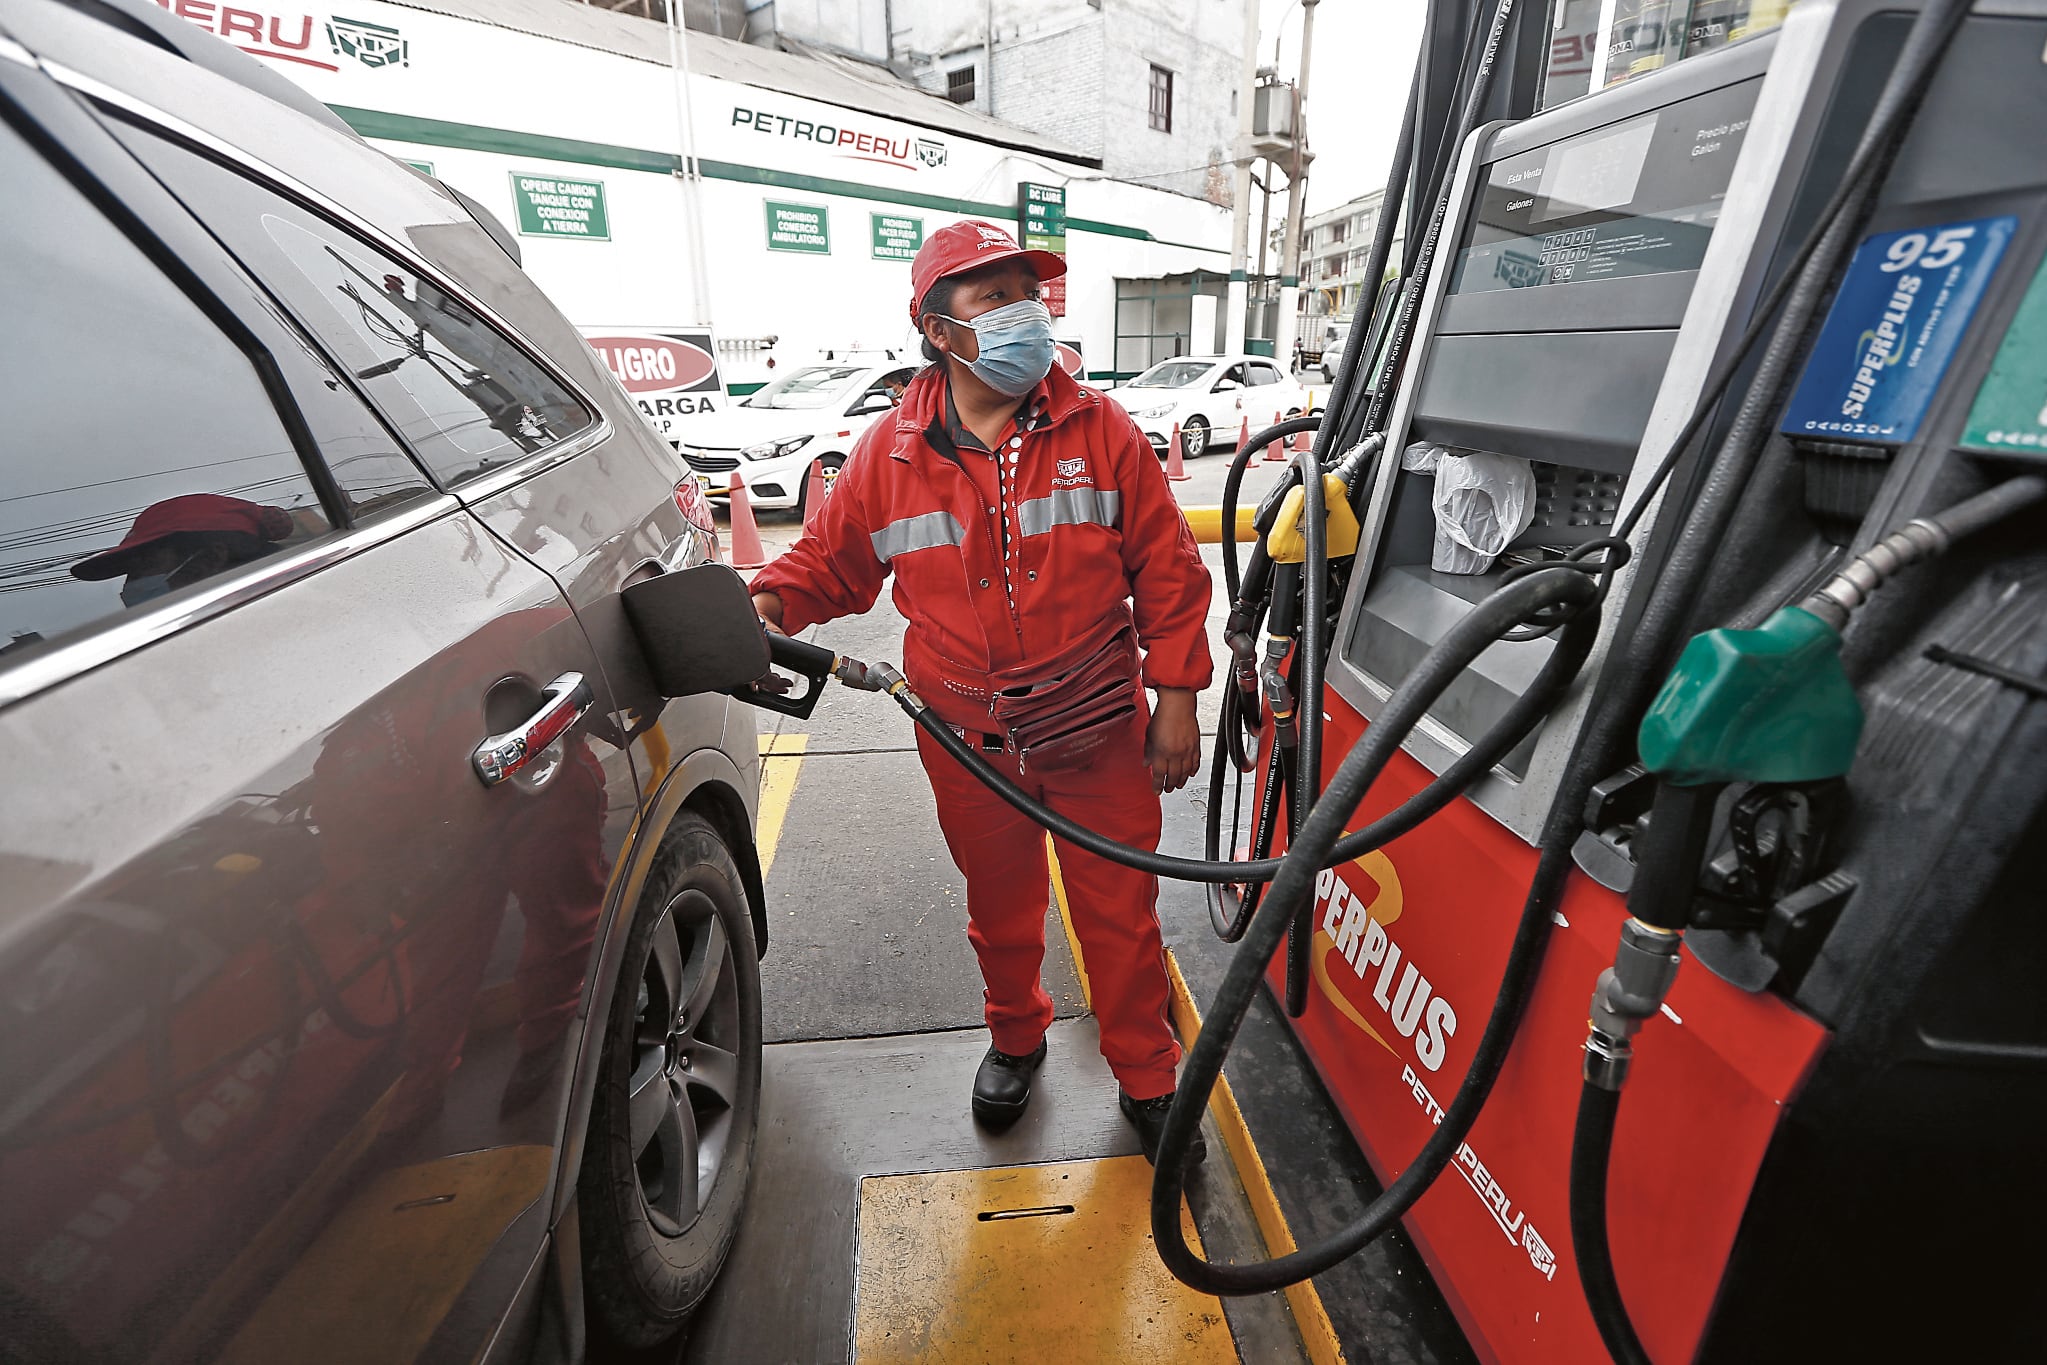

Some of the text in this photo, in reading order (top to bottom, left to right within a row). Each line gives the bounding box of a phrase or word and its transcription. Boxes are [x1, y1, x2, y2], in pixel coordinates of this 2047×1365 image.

[156, 0, 313, 50] ERU
[1485, 24, 1505, 64] BALFLEX
[732, 107, 910, 160] PETROPERU
[1696, 125, 1729, 141] Precio
[1507, 167, 1543, 185] Esta Venta
[520, 178, 597, 197] OPERE CAMION
[528, 192, 594, 209] TANQUE CON
[1506, 198, 1534, 212] Galones
[537, 206, 590, 222] CONEXION
[776, 209, 819, 225] PROHIBIDO
[542, 220, 589, 233] A TIERRA
[777, 220, 819, 235] COMERCIO
[771, 231, 826, 246] AMBULATORIO
[1879, 226, 1977, 273] 95
[1842, 274, 1922, 420] SUPERPLUS
[594, 347, 676, 381] LIGRO
[1805, 420, 1894, 435] GASOHOL
[1051, 476, 1093, 486] PETROPERU
